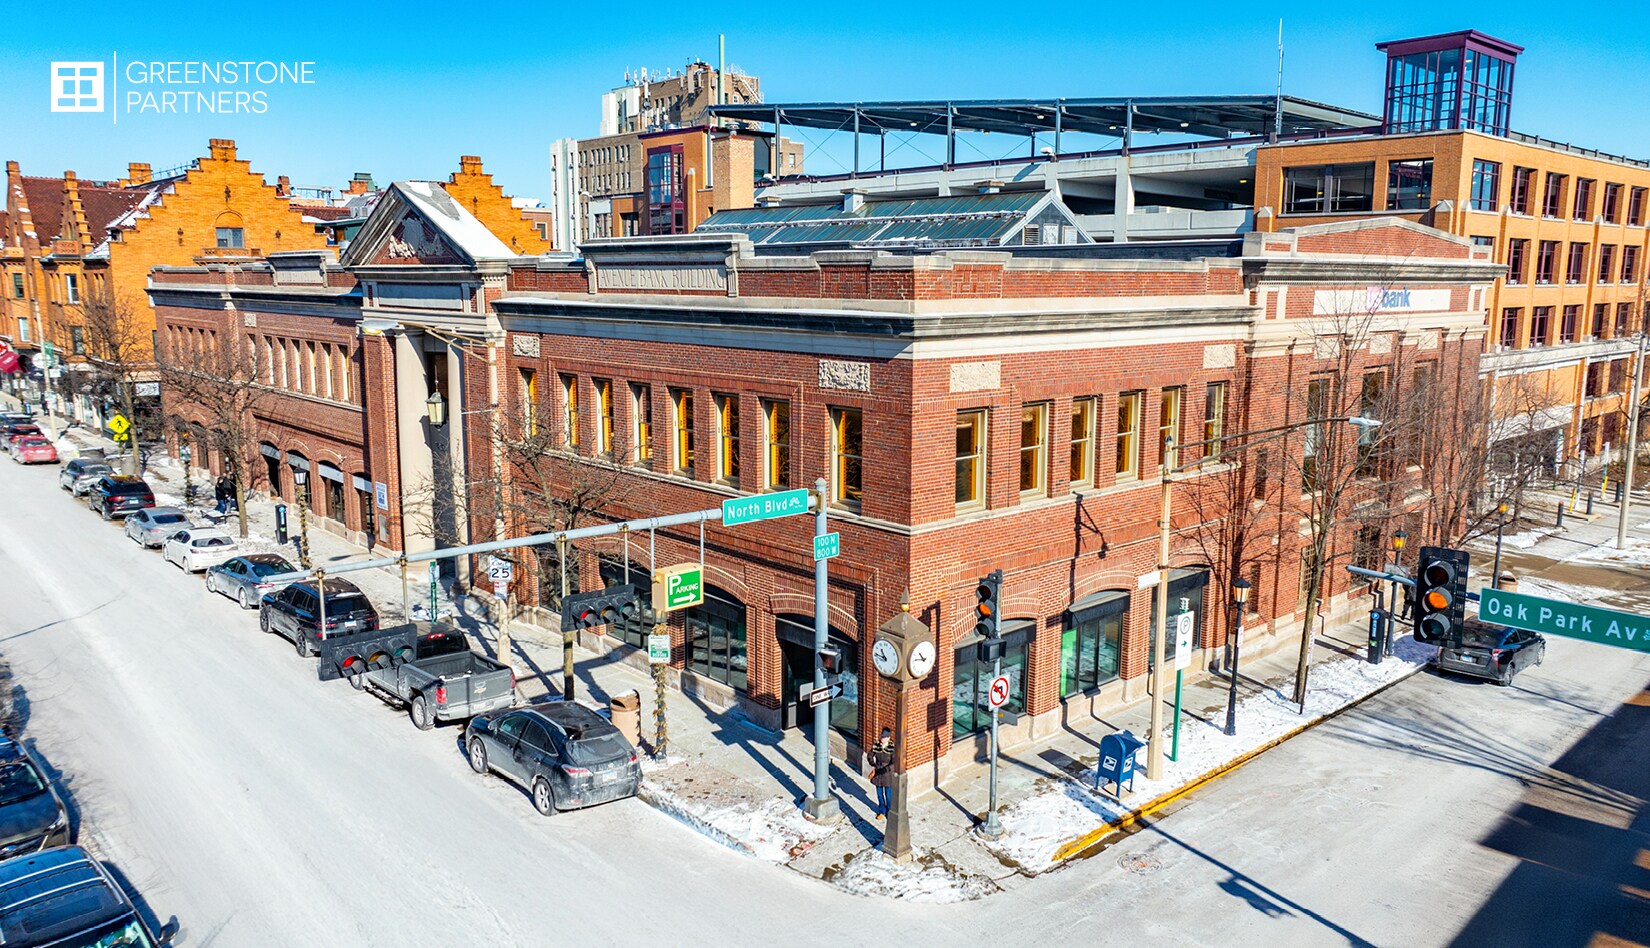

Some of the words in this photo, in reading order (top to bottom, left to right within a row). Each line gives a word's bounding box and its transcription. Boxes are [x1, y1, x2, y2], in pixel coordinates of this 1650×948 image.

[600, 268, 636, 287] AVENUE
[640, 268, 668, 288] BANK
[672, 269, 725, 288] BUILDING
[1381, 287, 1411, 308] bank
[728, 503, 760, 519] North
[765, 498, 787, 513] Blvd
[818, 537, 829, 547] 100
[830, 536, 835, 544] N
[817, 548, 830, 558] 800
[491, 568, 510, 578] 25
[669, 575, 699, 595] PARKING
[1488, 598, 1528, 621] Oak
[1539, 607, 1592, 633] Park
[1605, 620, 1637, 641] Av
